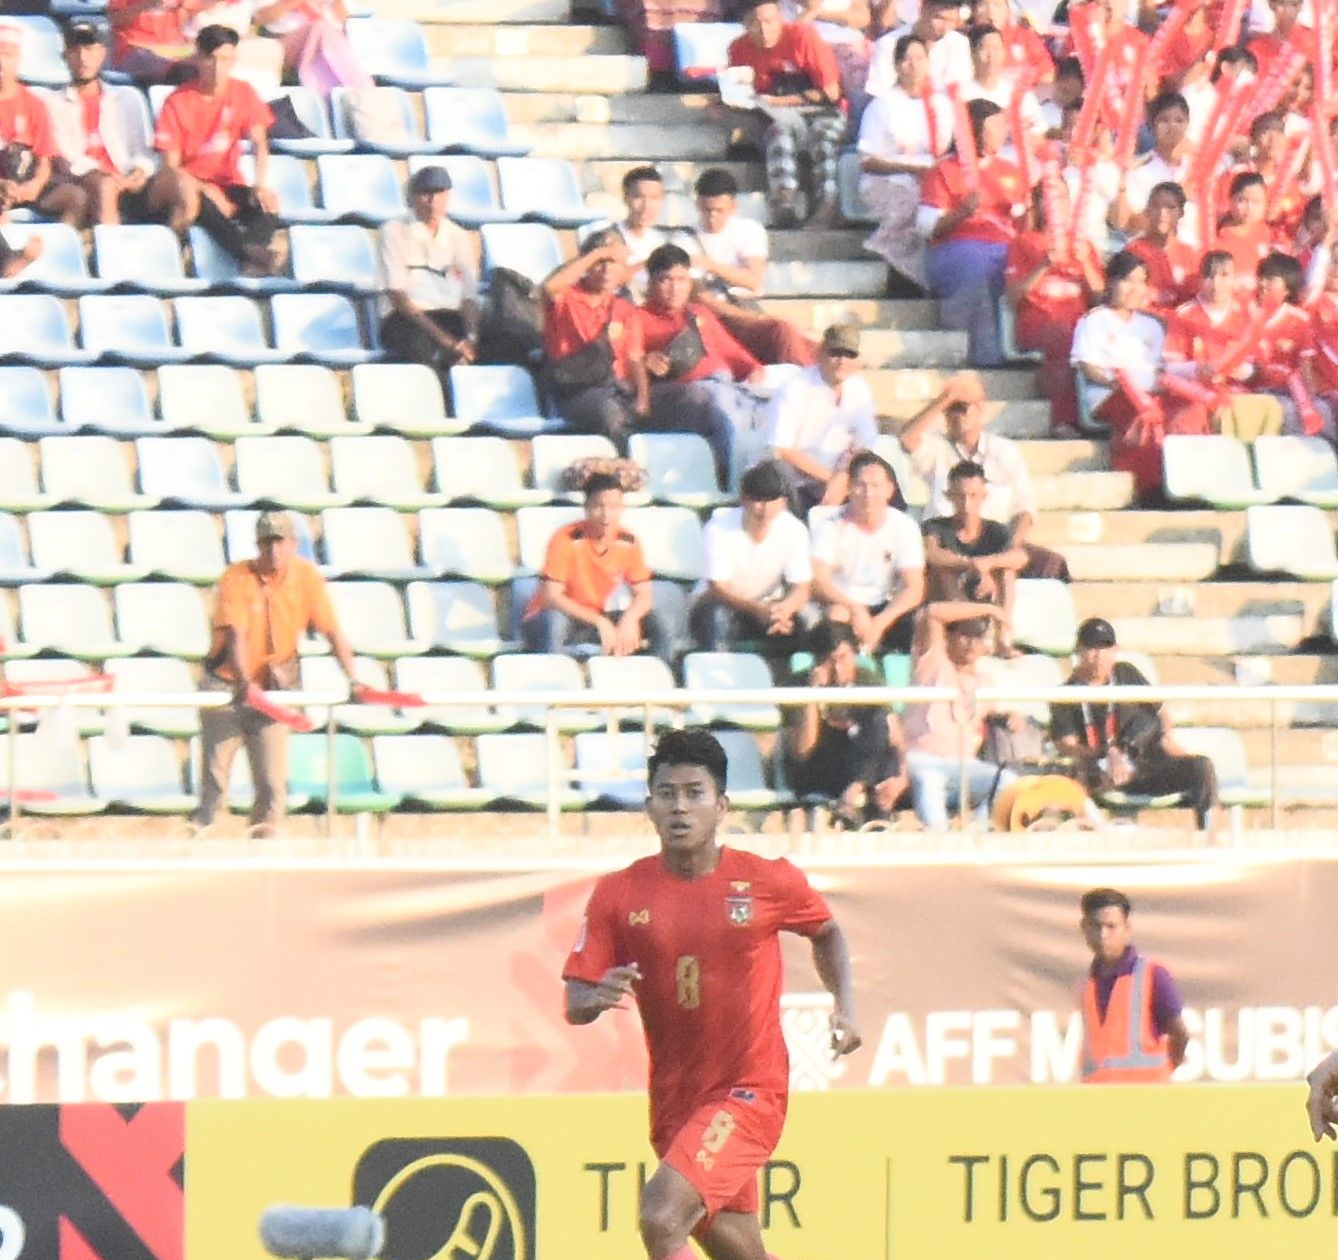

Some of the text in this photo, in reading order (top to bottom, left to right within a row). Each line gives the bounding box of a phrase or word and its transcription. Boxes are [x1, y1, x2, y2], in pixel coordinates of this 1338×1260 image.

[676, 954, 700, 1009] 8
[0, 990, 469, 1099] hanger
[867, 1009, 1021, 1085] AFF
[701, 1109, 737, 1153] 8
[948, 1151, 1156, 1223] TIGER
